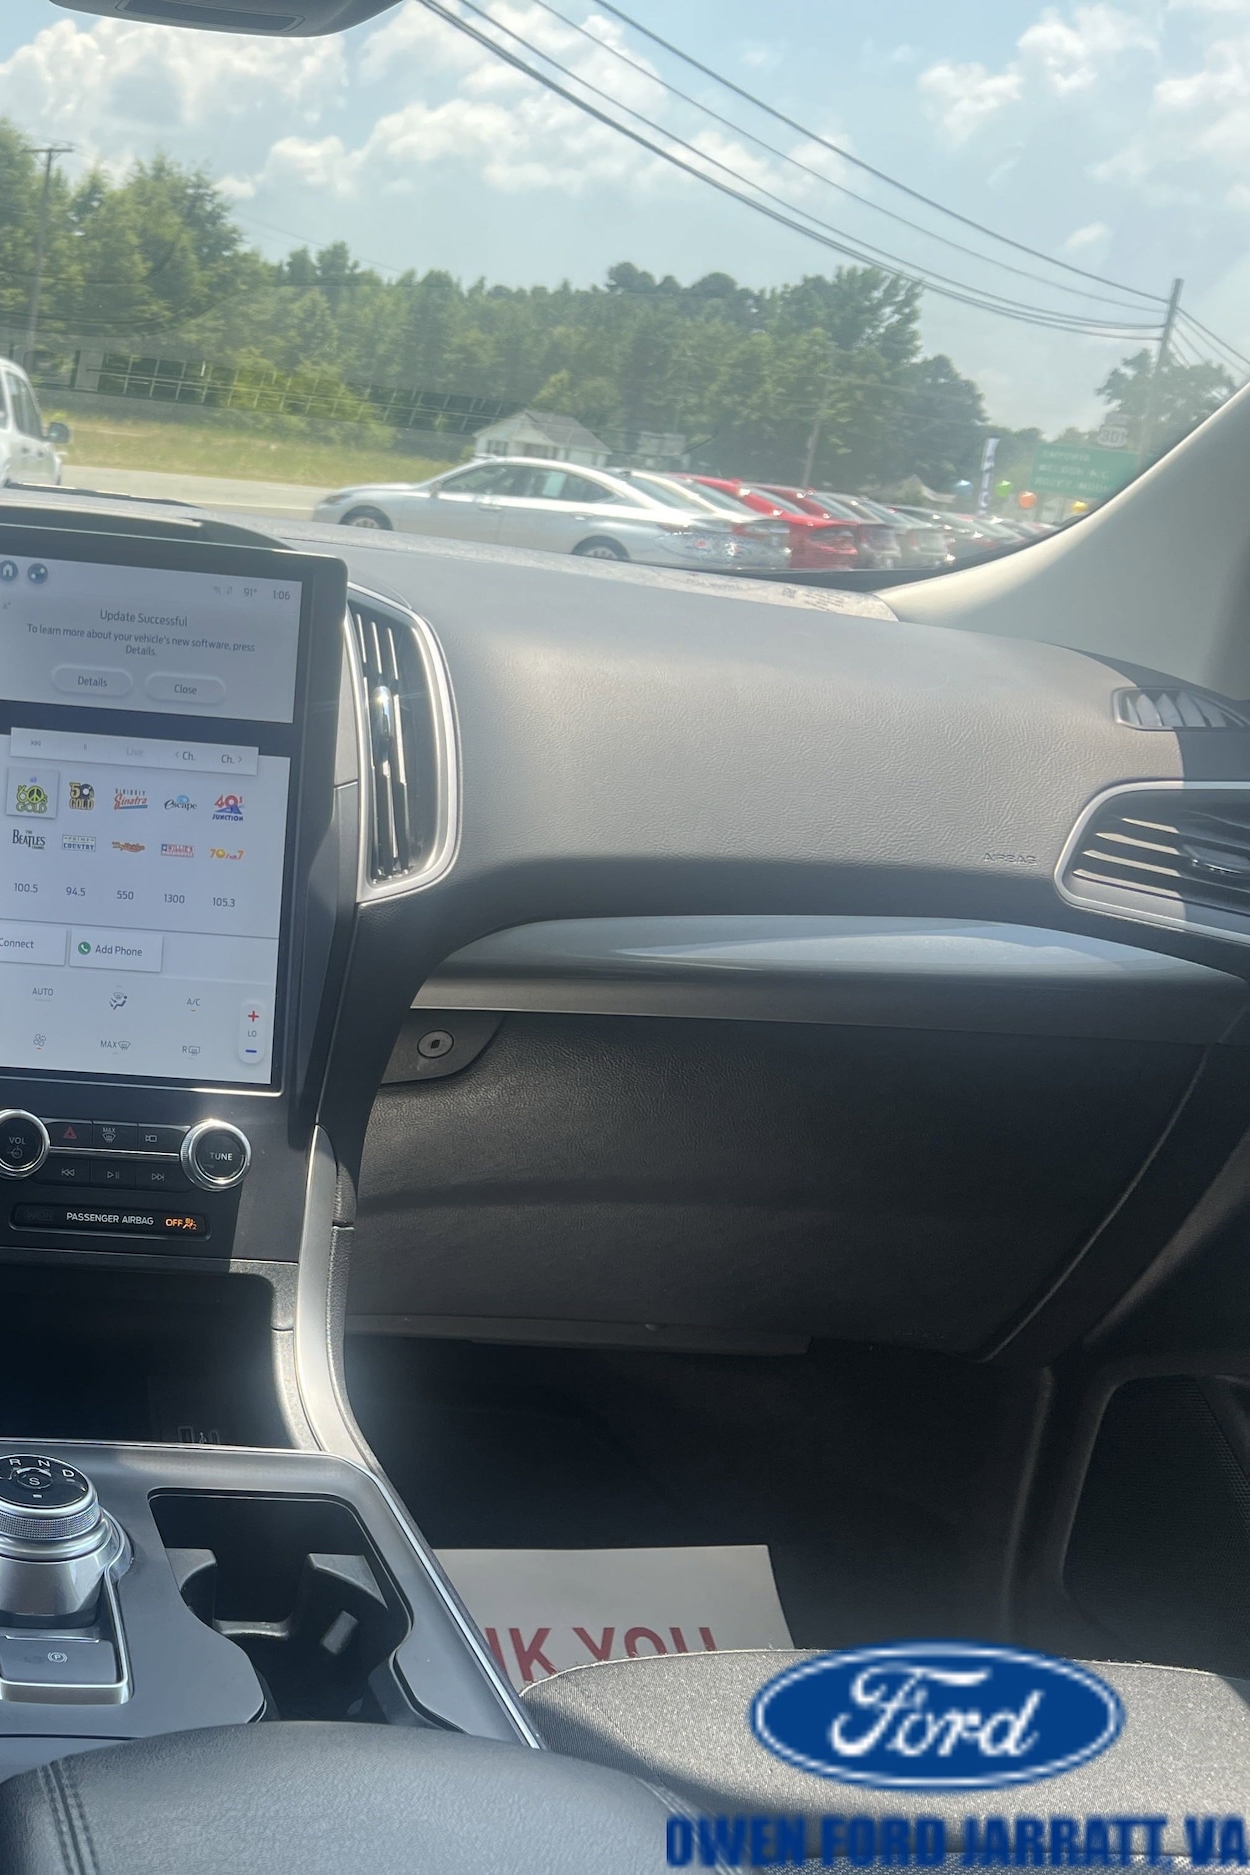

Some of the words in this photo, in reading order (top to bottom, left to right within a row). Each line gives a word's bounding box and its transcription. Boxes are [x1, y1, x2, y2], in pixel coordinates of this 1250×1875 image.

[272, 589, 291, 601] 1:06
[99, 608, 136, 623] Update
[137, 612, 188, 628] Successful
[27, 623, 38, 634] To
[39, 624, 61, 636] learn
[62, 628, 85, 638] more
[86, 629, 111, 640] about
[113, 632, 132, 642] your
[134, 633, 171, 645] vehicle's
[171, 638, 190, 647] new
[191, 638, 231, 651] software,
[232, 642, 255, 653] press
[125, 644, 158, 657] Details.
[77, 674, 108, 689] Details
[173, 682, 198, 696] Close
[181, 750, 196, 763] Ch.
[220, 753, 235, 766] Ch.
[69, 799, 94, 811] GOLD
[212, 813, 244, 822] JUNCTION
[12, 829, 46, 847] BEATLES
[63, 843, 95, 851] COUNTRY
[983, 853, 1038, 866] AIRBAG
[13, 882, 39, 895] 100.5
[65, 886, 86, 898] 94.5
[116, 890, 134, 901] 550
[163, 893, 185, 905] 1300
[212, 897, 236, 909] 105.3
[95, 944, 113, 956] Add
[115, 945, 143, 958] Phone
[32, 987, 55, 998] AUTO
[186, 997, 201, 1008] A/C
[247, 1030, 257, 1038] LO
[100, 1039, 118, 1050] MAX
[8, 1136, 26, 1146] VOL
[209, 1152, 233, 1161] TUNE
[66, 1212, 120, 1224] PASSENGER
[122, 1216, 154, 1226] AIRBAG
[165, 1217, 184, 1228] OFF
[9, 1458, 22, 1466] R
[38, 1459, 51, 1468] N
[62, 1469, 75, 1478] D
[28, 1476, 41, 1486] S
